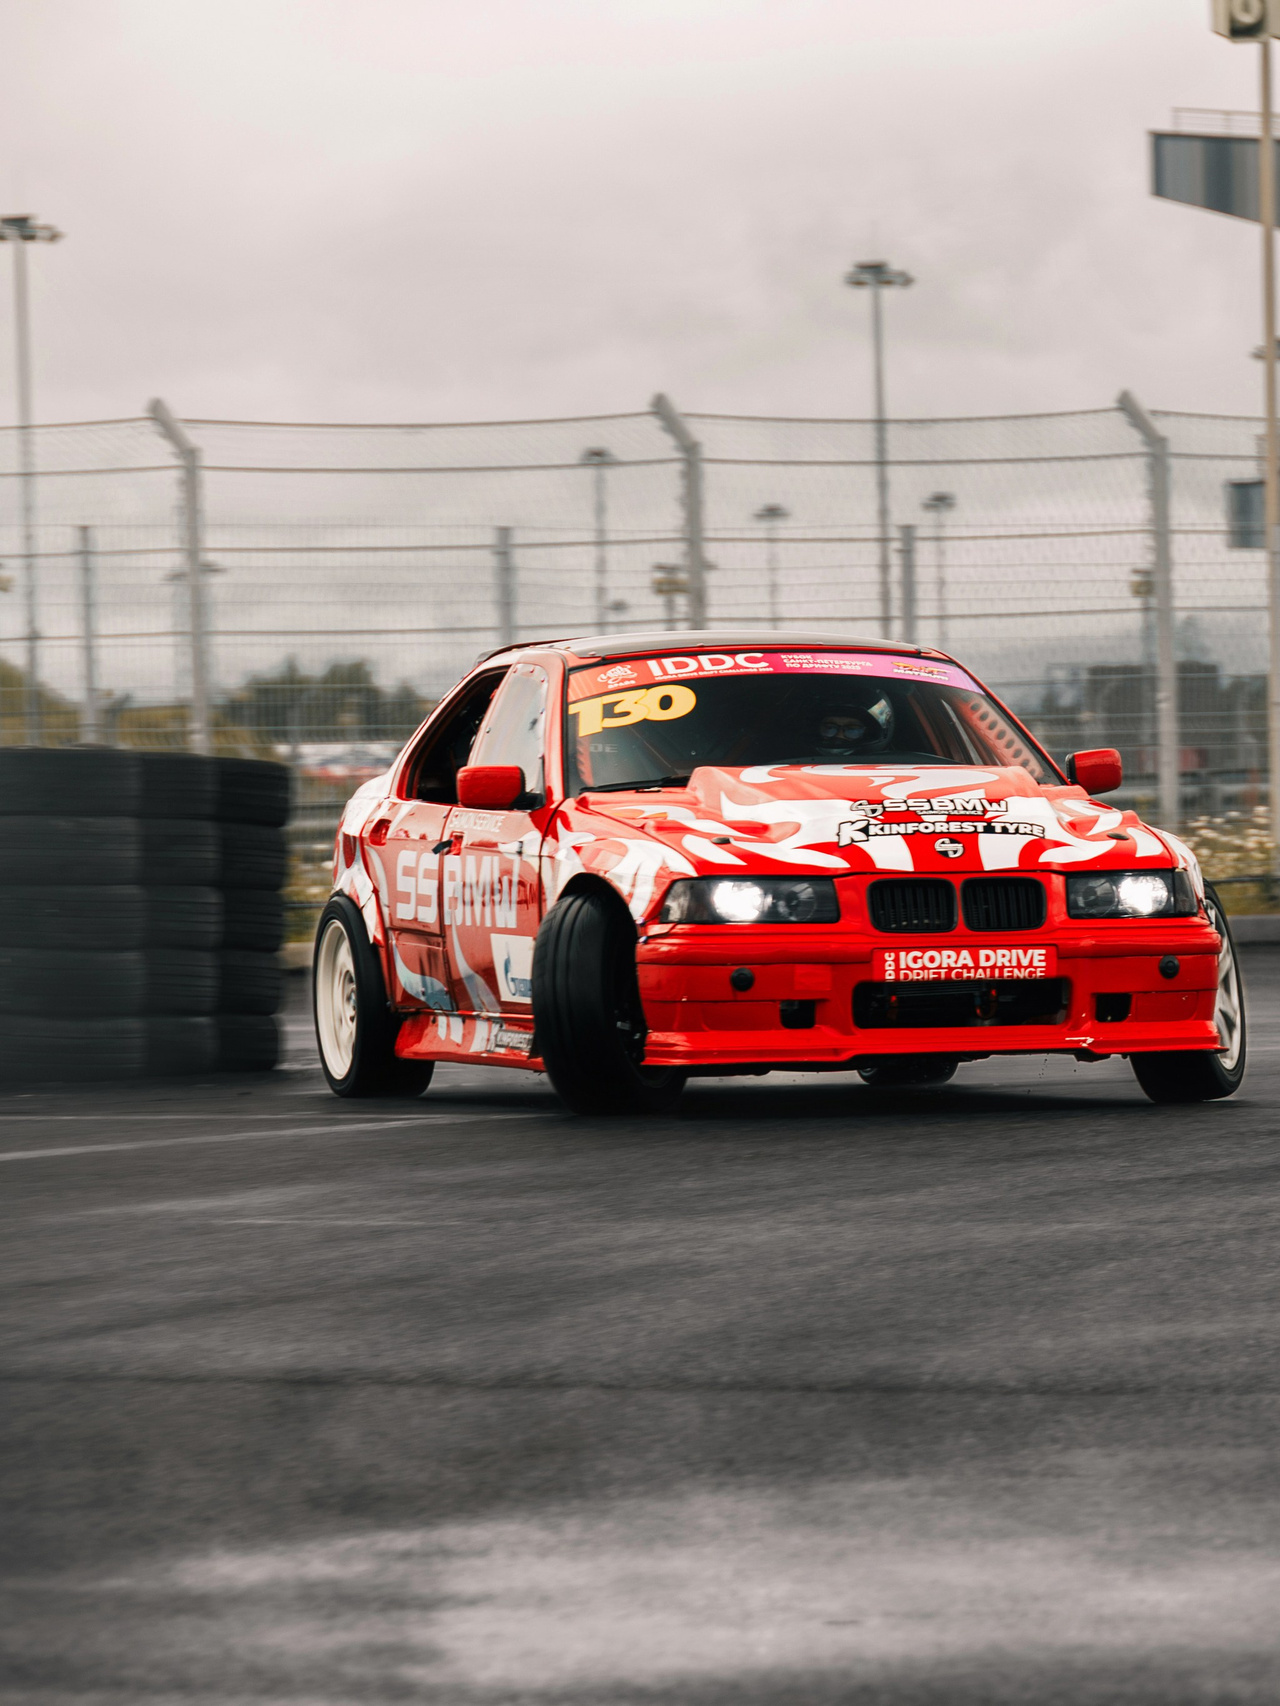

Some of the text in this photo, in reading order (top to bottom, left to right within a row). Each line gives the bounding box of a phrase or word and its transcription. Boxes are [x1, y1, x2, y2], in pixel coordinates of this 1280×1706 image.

[647, 653, 769, 676] IDDC
[568, 684, 697, 737] 130
[882, 798, 1008, 812] SSBMW
[868, 821, 987, 836] KINFOREST
[990, 822, 1045, 838] TYRE
[396, 849, 521, 929] SSBMW
[899, 949, 1047, 969] IGORA DRIVE
[899, 967, 1046, 982] DRIFT CHALLENGE
